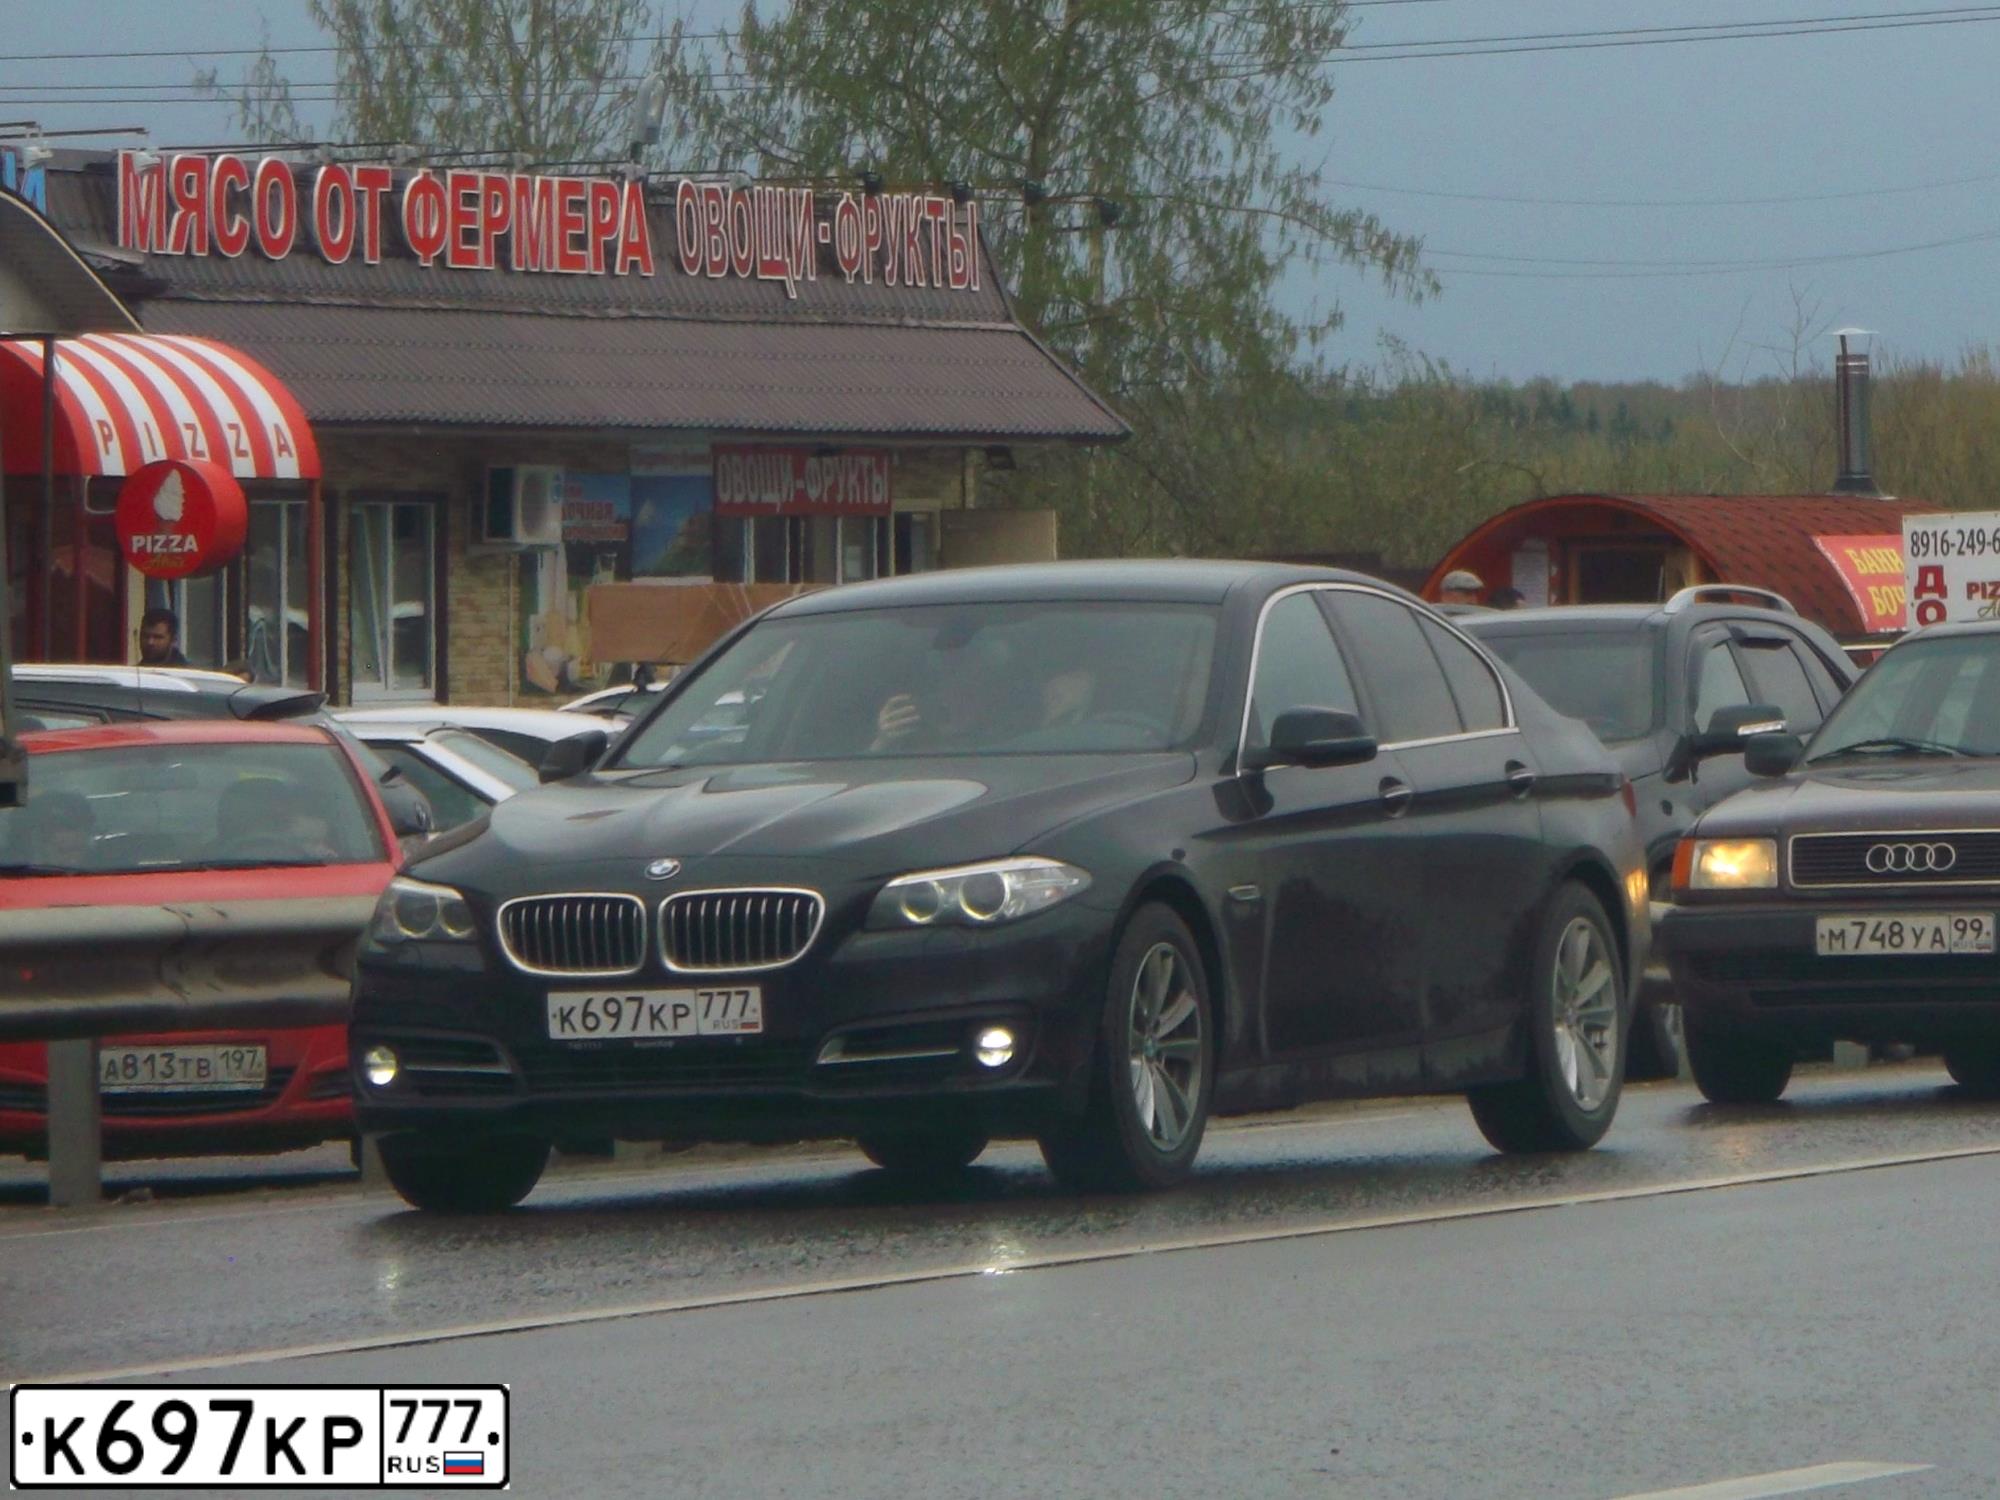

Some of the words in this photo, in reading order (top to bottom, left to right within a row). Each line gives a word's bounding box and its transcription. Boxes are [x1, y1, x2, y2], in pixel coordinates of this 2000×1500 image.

[119, 150, 298, 260] МЯСО
[314, 164, 392, 264] ОТ
[403, 168, 655, 277] ФЕРМЕРА
[676, 178, 980, 299] ОВОЩИ-ФРУКТЫ
[96, 419, 294, 459] PIZZA
[131, 534, 199, 553] PIZZA
[1828, 920, 1946, 951] М748УА
[1954, 918, 1984, 940] 99
[559, 996, 690, 1033] К697КР
[699, 990, 751, 1019] 777
[713, 1019, 741, 1031] RUS
[104, 1052, 211, 1081] А813ТВ
[220, 1049, 258, 1071] 197
